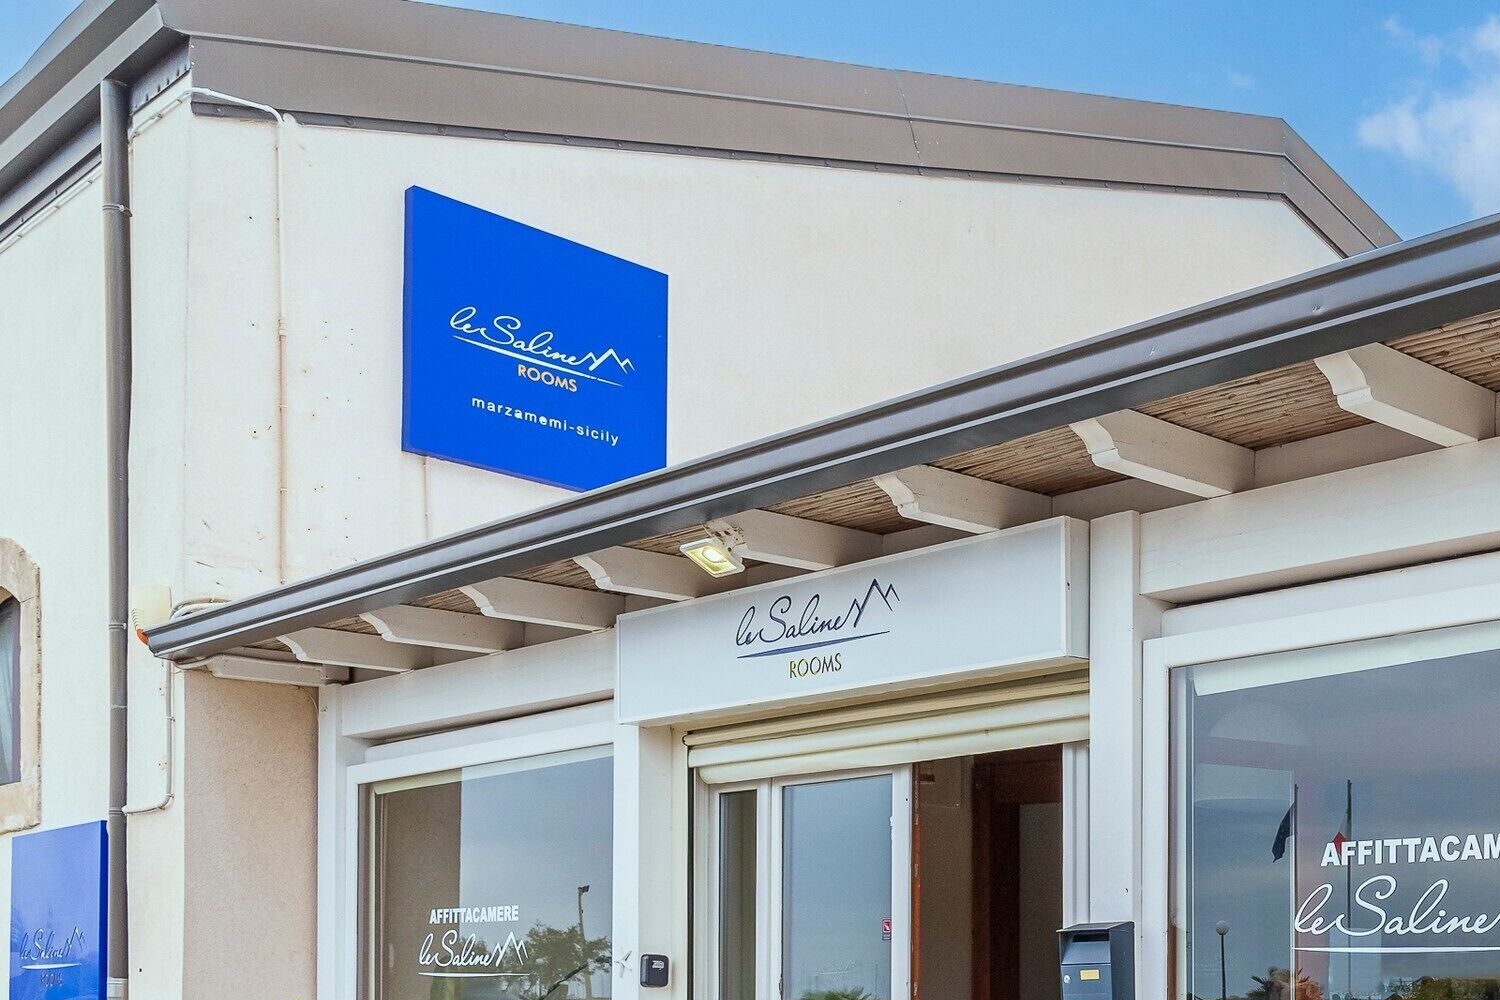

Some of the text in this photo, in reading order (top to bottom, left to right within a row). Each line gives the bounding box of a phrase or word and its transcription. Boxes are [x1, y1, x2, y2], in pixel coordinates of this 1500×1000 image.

[449, 306, 583, 365] le Saline
[517, 364, 578, 393] ROOMS
[471, 397, 620, 447] marzamemi-sicily
[735, 593, 846, 646] le Saline
[789, 652, 842, 679] ROOMS
[429, 905, 520, 924] AFFITTACAMERE
[1294, 874, 1492, 937] le Saline
[418, 929, 492, 967] le Saline
